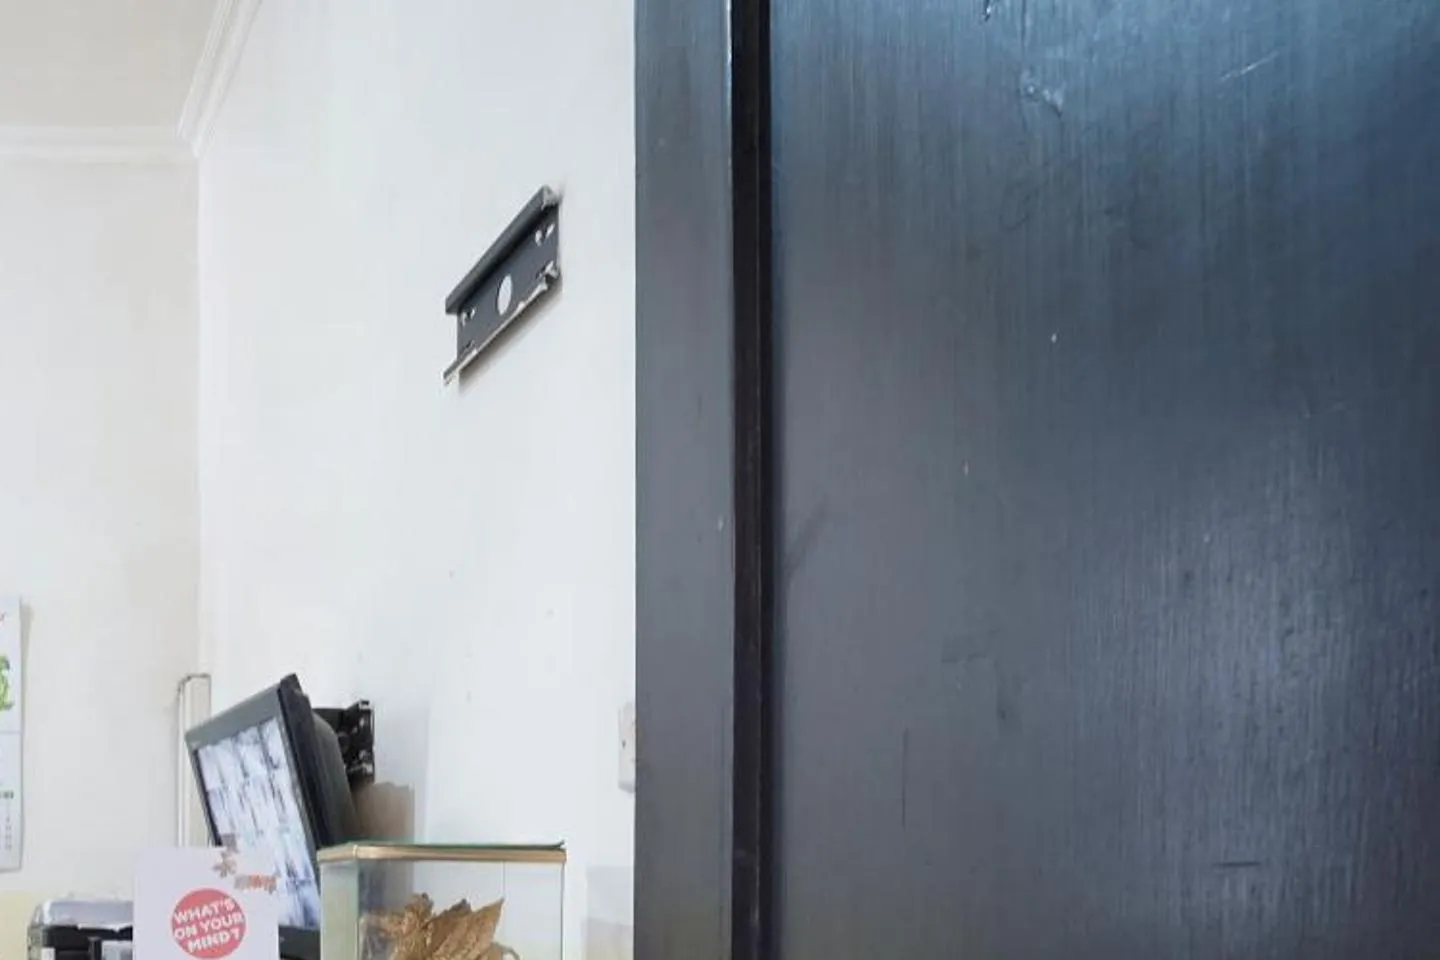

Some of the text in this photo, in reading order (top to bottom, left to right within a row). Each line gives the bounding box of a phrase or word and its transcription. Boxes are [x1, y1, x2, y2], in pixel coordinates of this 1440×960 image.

[174, 898, 236, 925] WHAT'S
[174, 911, 244, 940] ON YOUR
[187, 927, 242, 953] MIND?
